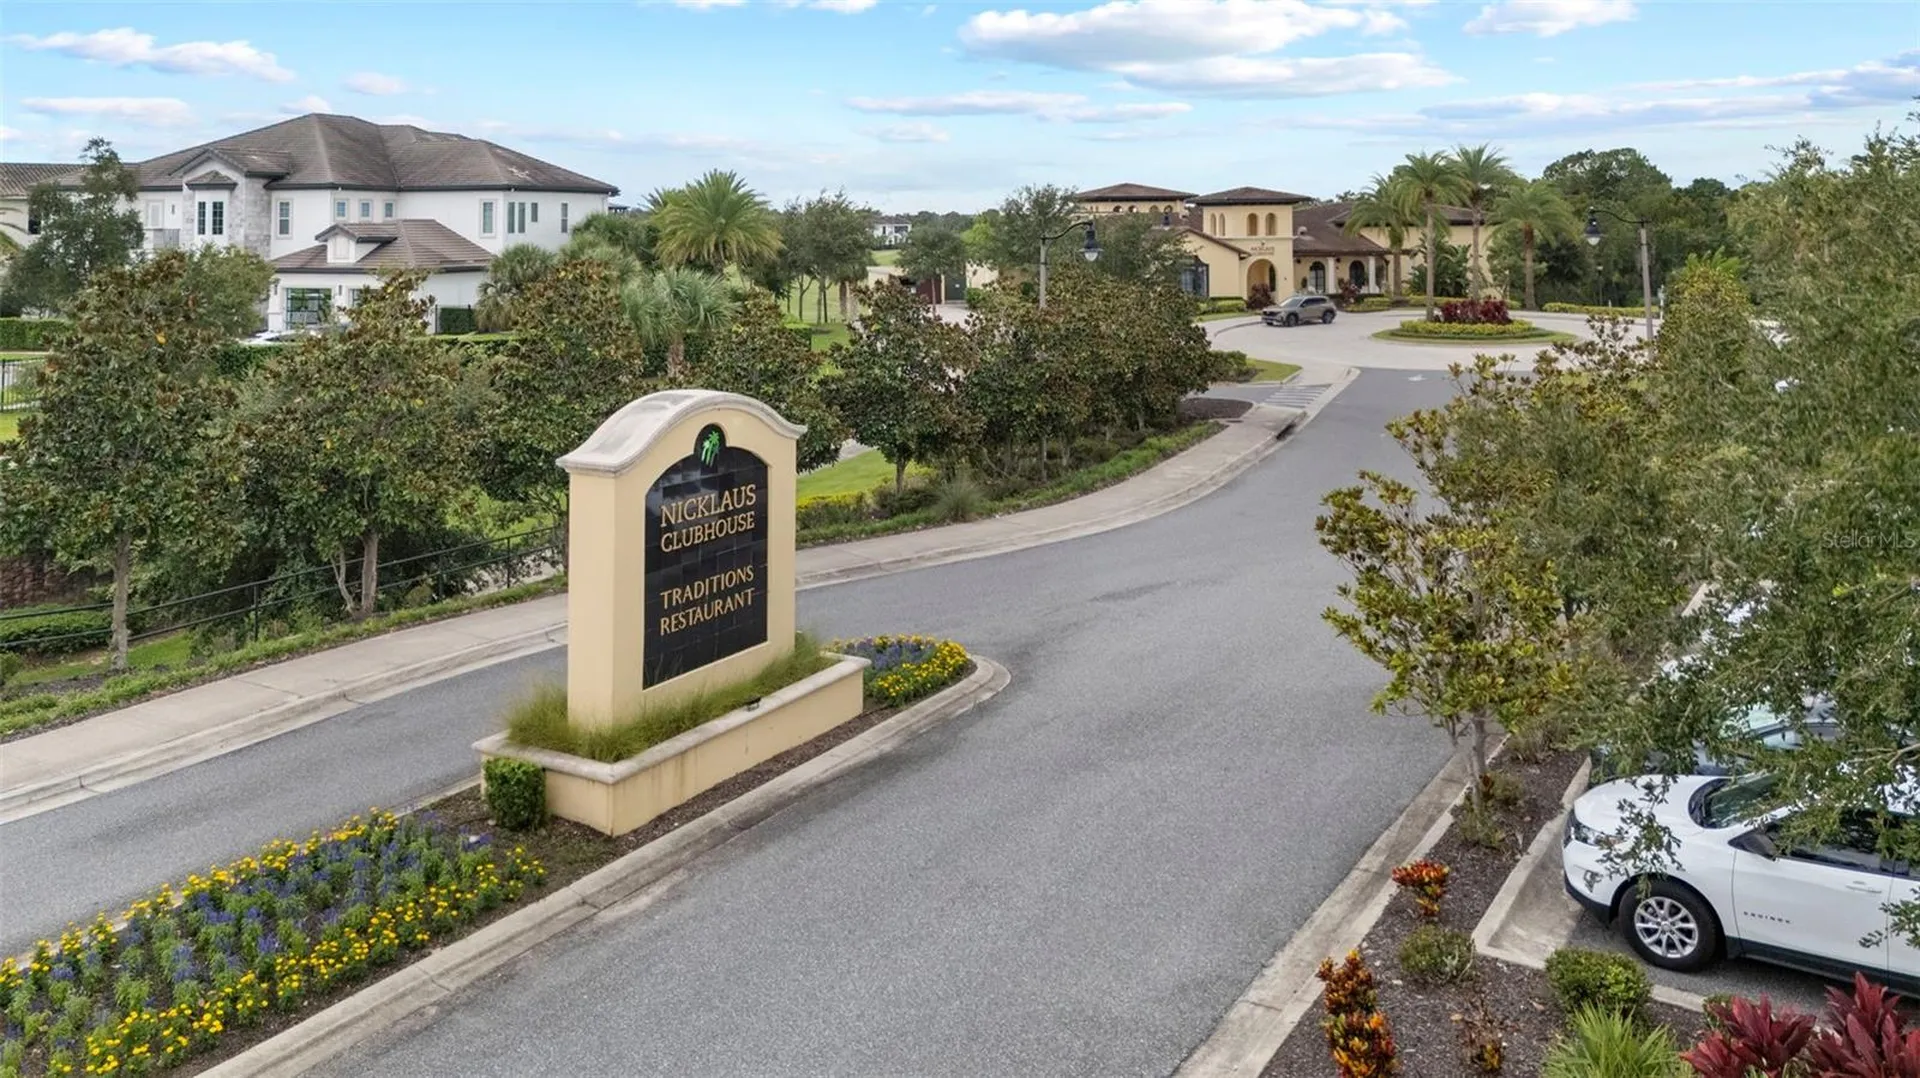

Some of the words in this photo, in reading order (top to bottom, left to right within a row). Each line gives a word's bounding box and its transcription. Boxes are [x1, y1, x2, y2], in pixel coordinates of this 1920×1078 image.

[660, 484, 756, 528] NICKLAUS
[661, 511, 755, 552] CLUBHOUSE
[660, 565, 754, 610] TRADITIONS
[660, 587, 755, 636] RESTAURANT
